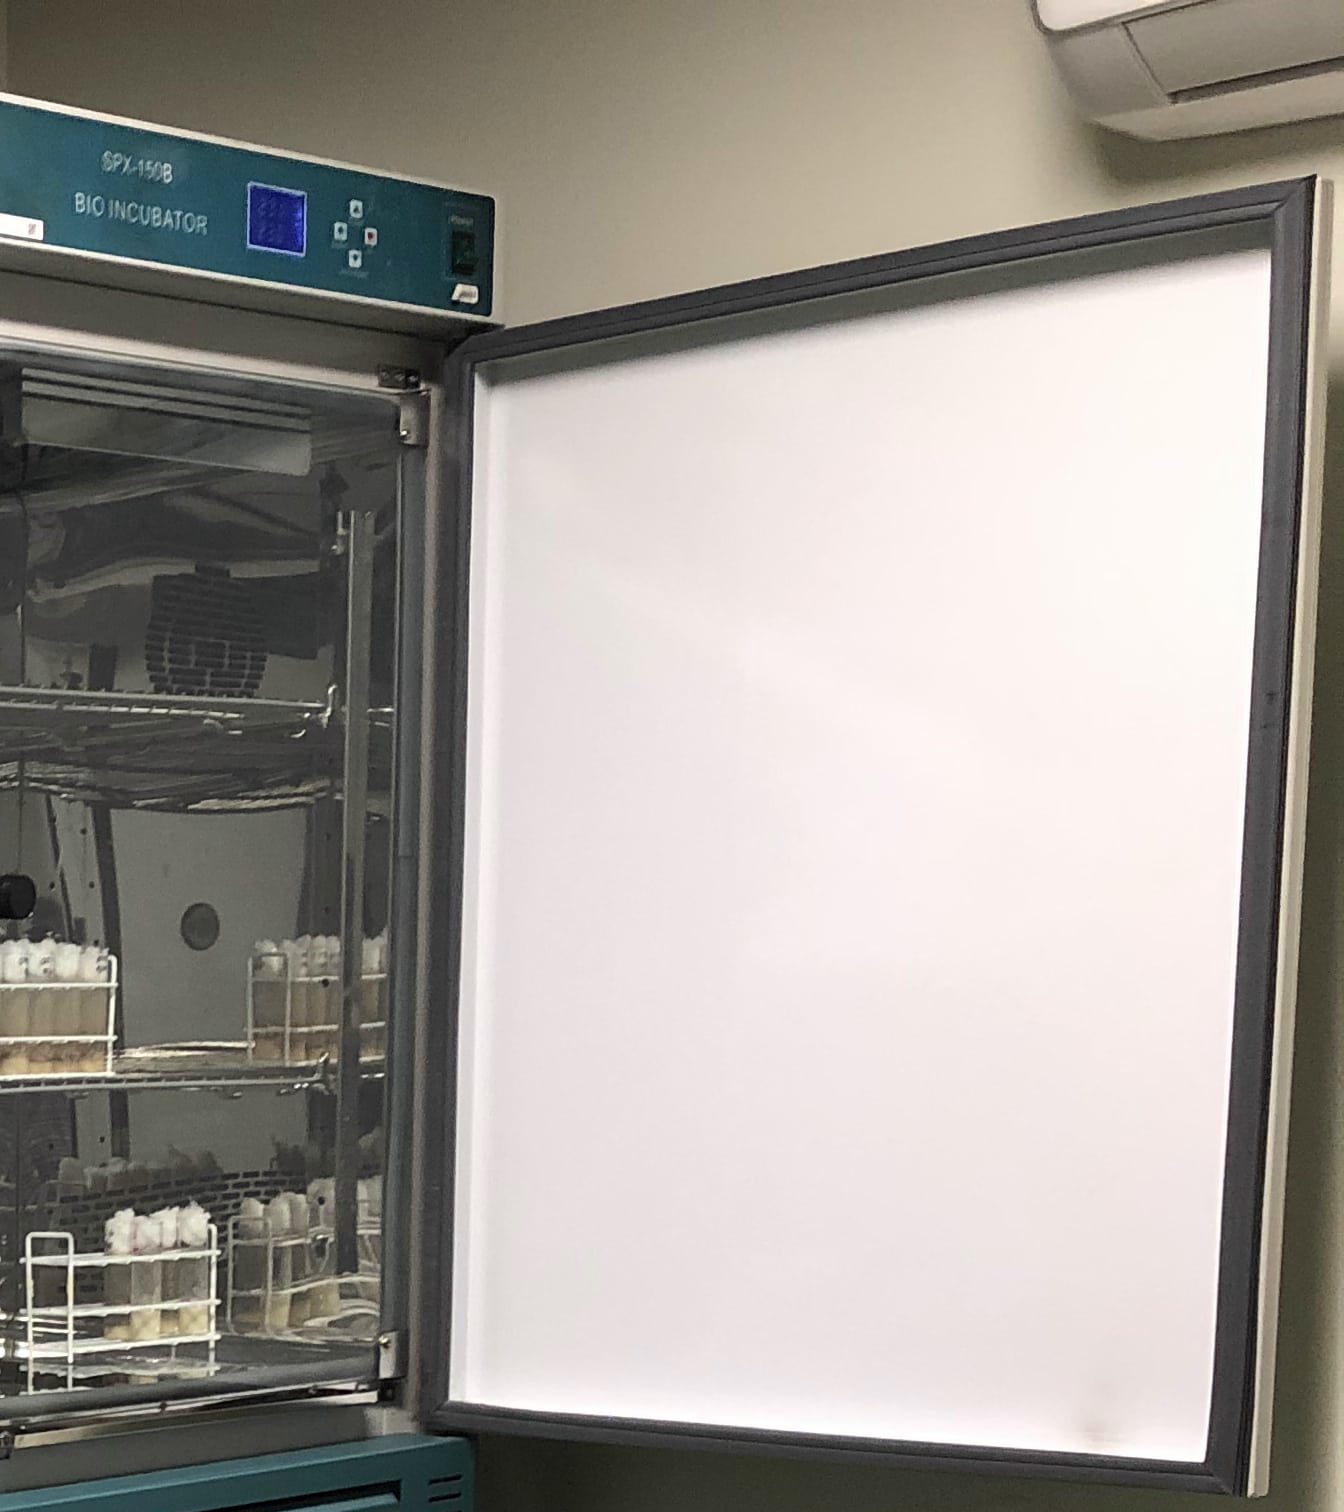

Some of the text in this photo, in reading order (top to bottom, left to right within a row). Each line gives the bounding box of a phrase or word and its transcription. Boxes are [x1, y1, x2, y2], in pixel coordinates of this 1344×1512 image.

[100, 150, 173, 184] SPX-150B
[74, 191, 208, 236] BIO INCUBATOR
